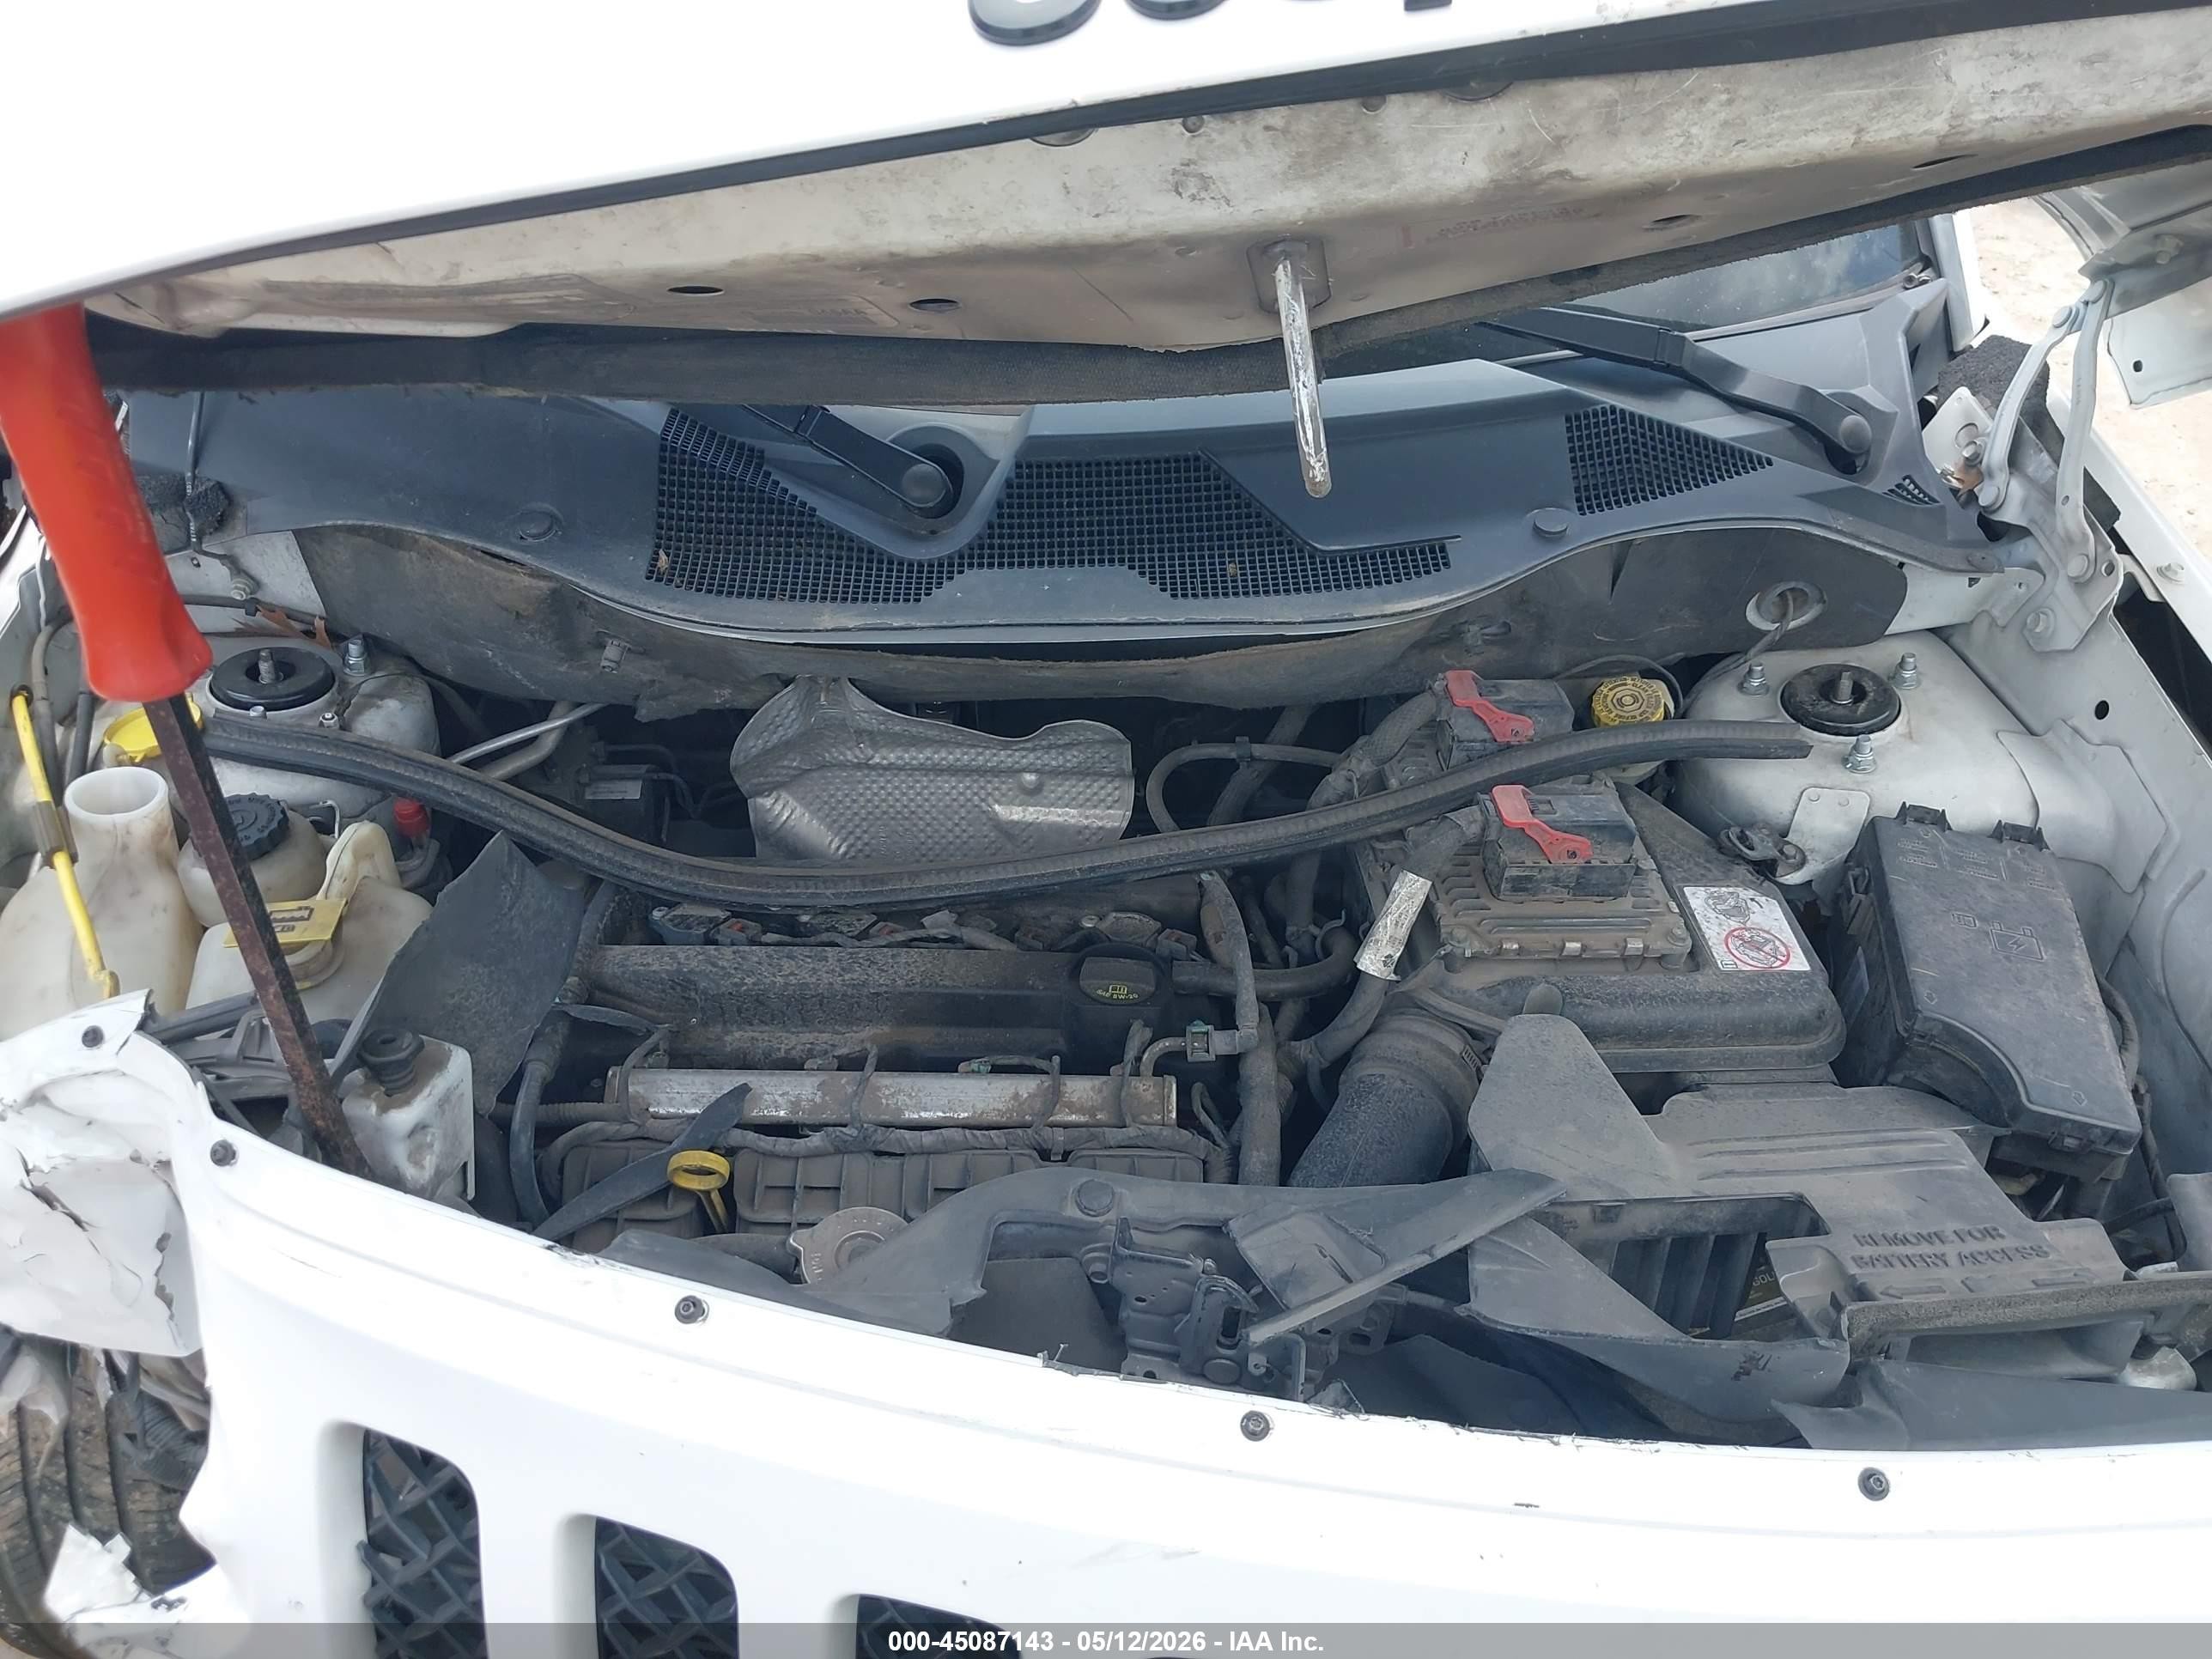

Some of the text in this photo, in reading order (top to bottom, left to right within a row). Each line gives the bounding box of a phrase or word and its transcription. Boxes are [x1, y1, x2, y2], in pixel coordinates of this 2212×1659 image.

[1853, 1224, 2006, 1247] REMOVE FOR
[1850, 1244, 2051, 1269] BATTERY ACCESS
